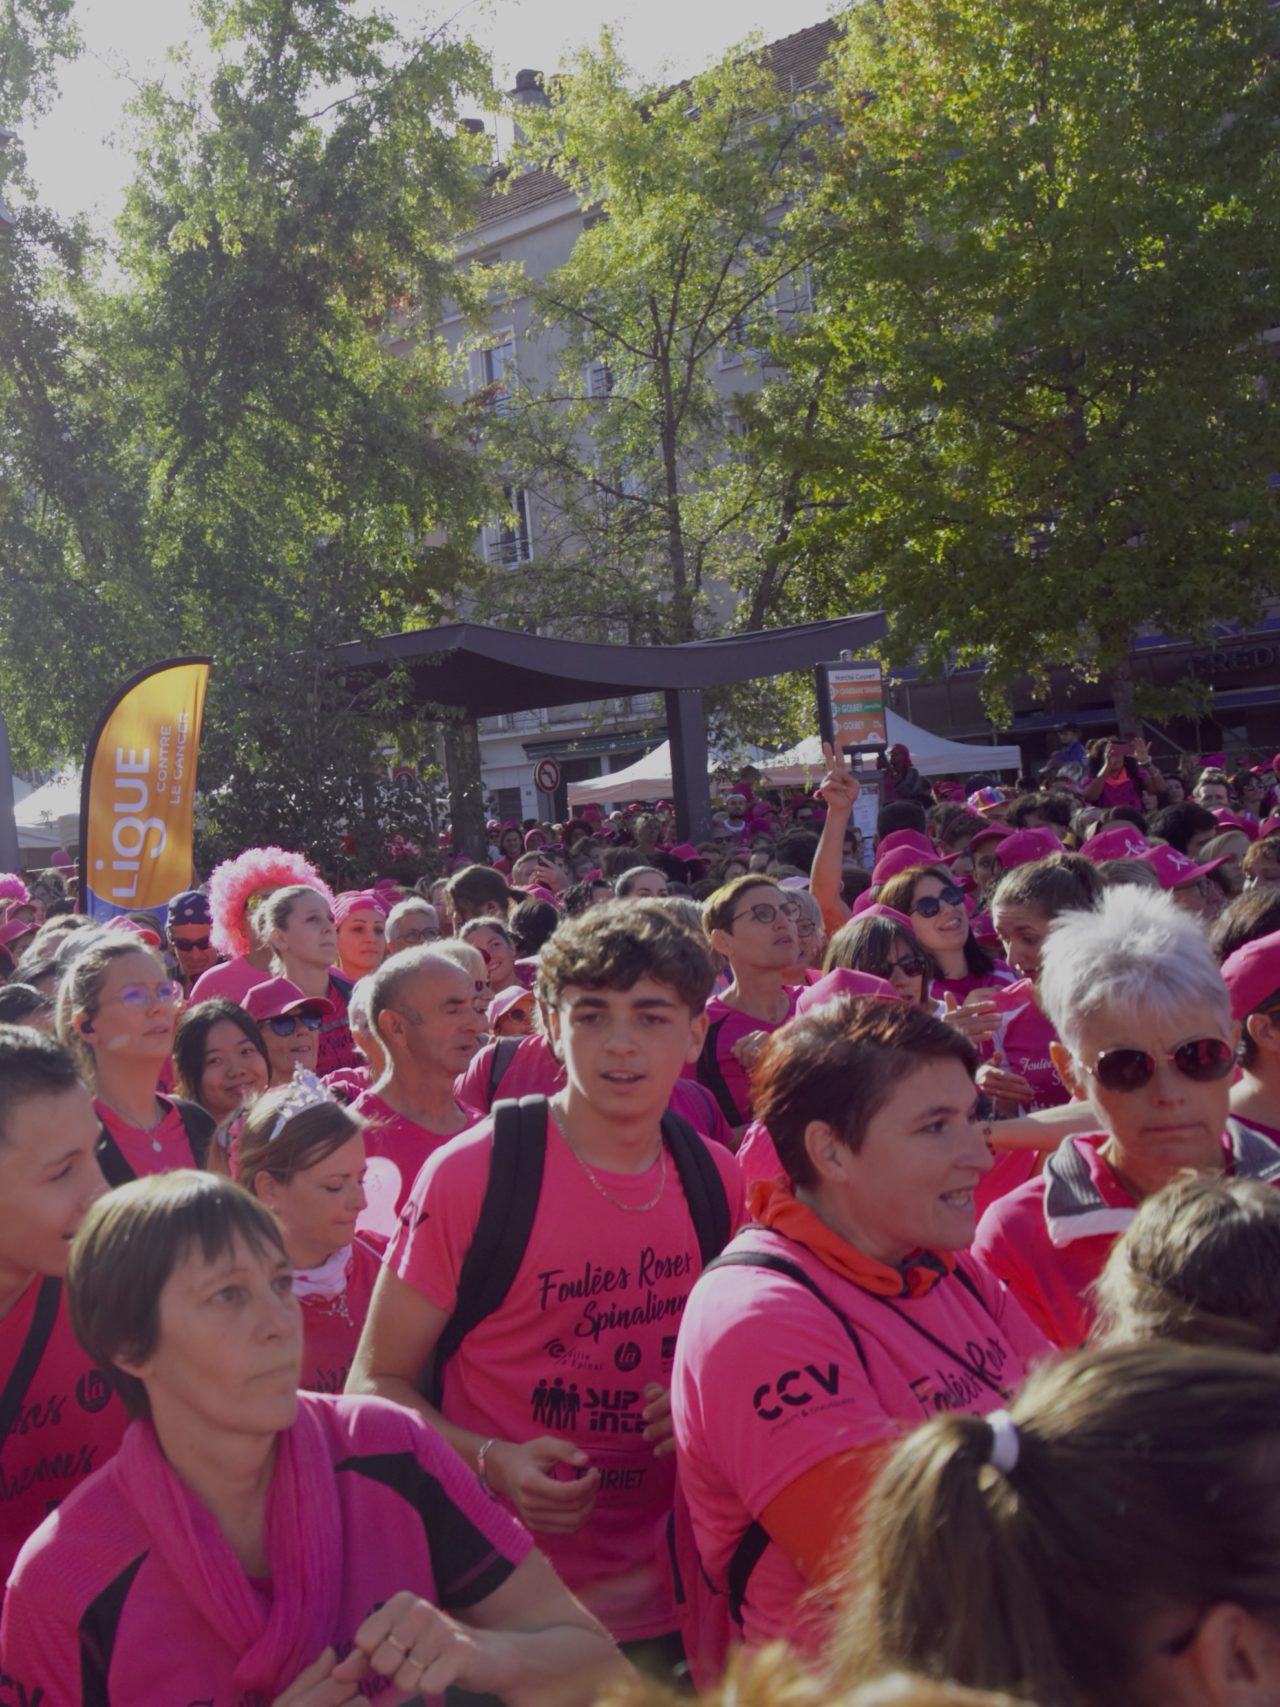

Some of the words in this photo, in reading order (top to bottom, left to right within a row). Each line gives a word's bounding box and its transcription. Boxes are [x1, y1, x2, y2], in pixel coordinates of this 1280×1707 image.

[156, 725, 172, 793] CONTRE
[173, 711, 190, 783] CANCER
[169, 785, 182, 806] LE
[536, 1261, 631, 1311] Foulées
[638, 1246, 693, 1290] Roses
[573, 1289, 688, 1345] Spinalienn
[582, 1387, 640, 1410] SUP
[753, 1361, 840, 1421] CCV
[572, 1466, 648, 1489] TIRIET
